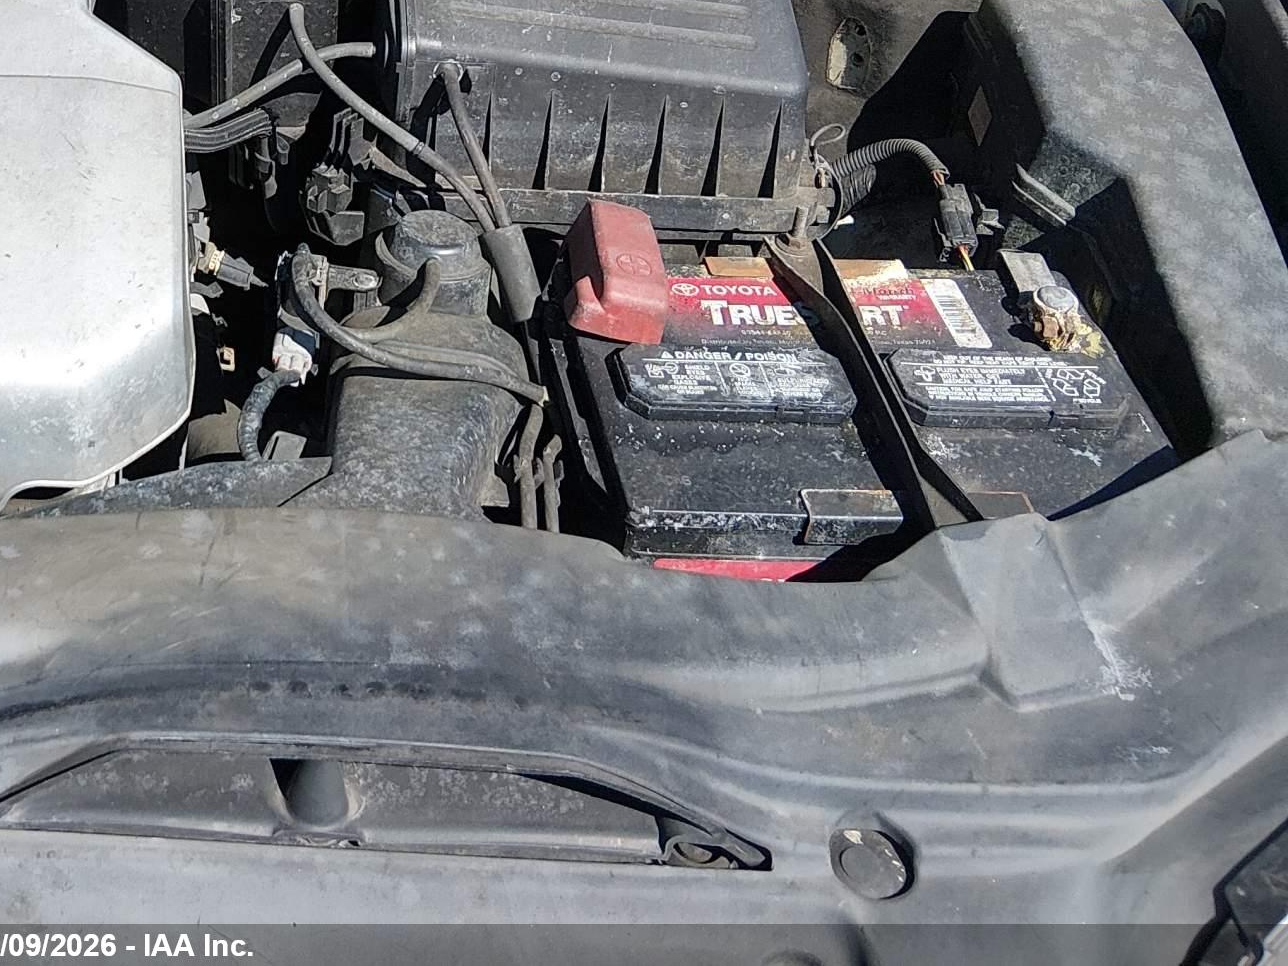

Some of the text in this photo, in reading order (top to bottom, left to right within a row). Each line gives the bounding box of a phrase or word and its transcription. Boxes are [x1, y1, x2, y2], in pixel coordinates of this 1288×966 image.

[700, 284, 777, 296] TOYOTA
[674, 351, 732, 360] DANGER
[745, 352, 798, 362] POISON
